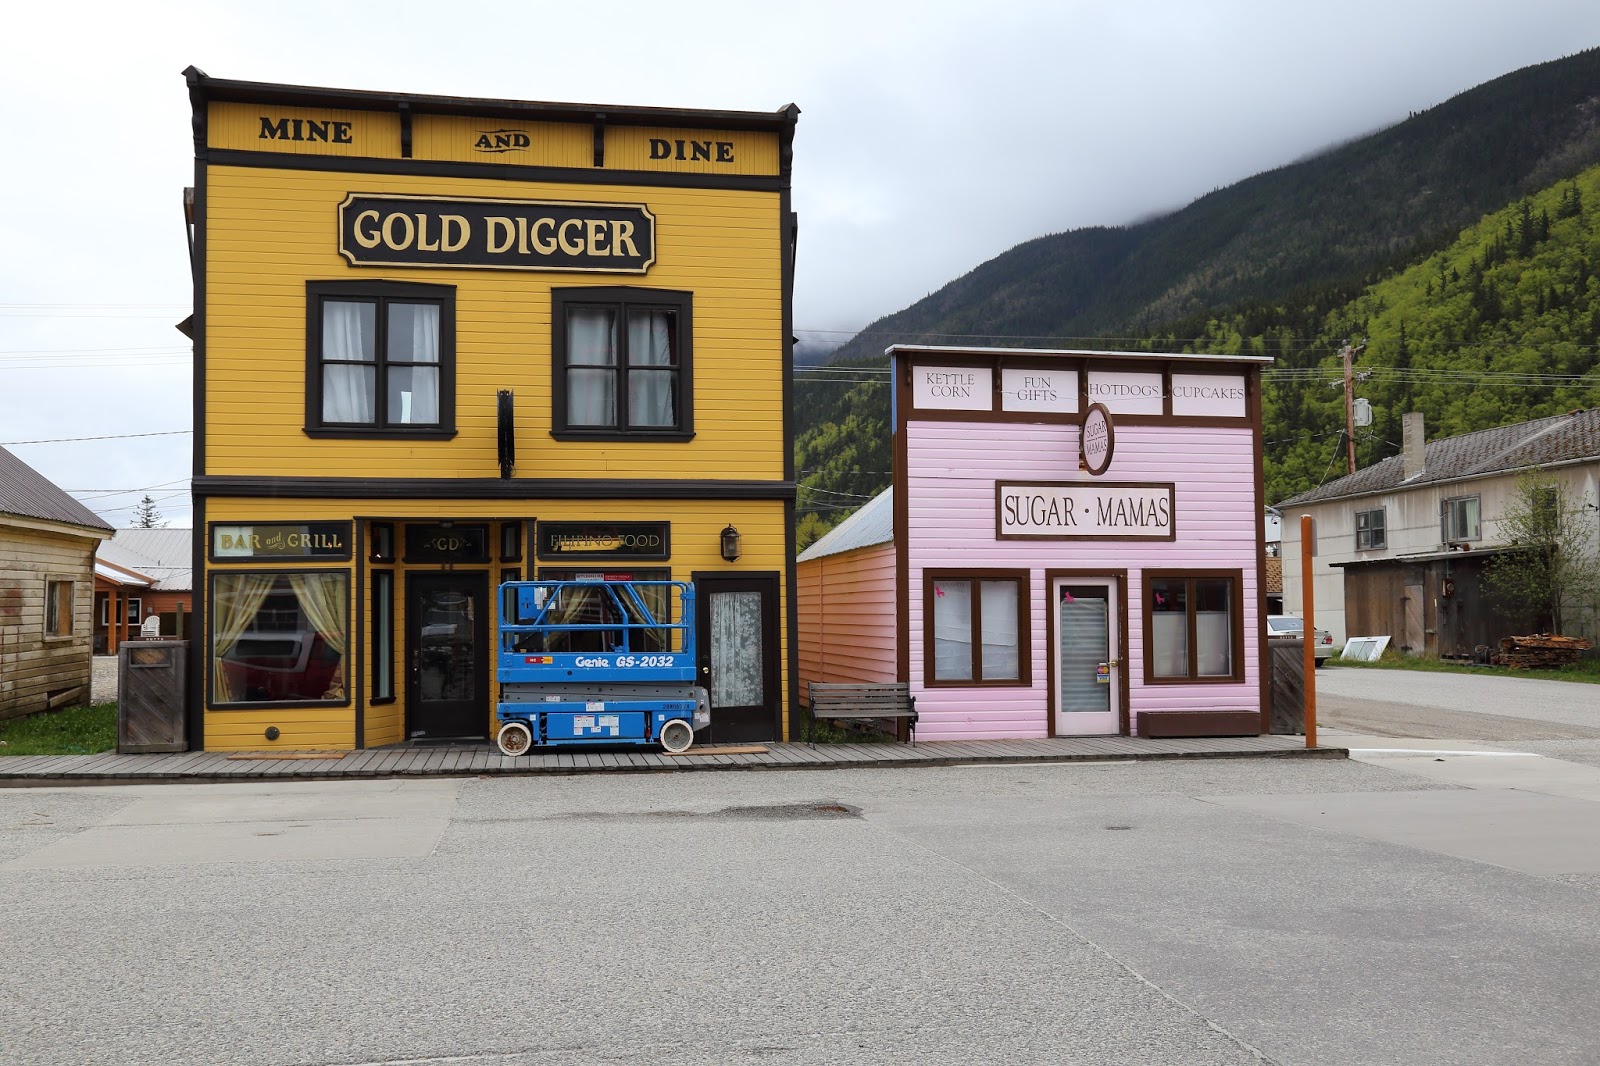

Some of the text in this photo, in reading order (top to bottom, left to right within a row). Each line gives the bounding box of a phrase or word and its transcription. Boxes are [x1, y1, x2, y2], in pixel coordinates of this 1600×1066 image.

[258, 116, 353, 143] MINE
[474, 133, 531, 151] AND
[649, 138, 735, 163] DINE
[353, 209, 640, 257] GOLD DIGGER
[926, 372, 975, 386] KETTLE
[1024, 377, 1051, 389] FUN
[931, 385, 971, 398] CORN
[1017, 389, 1057, 402] GIFTS
[1089, 383, 1159, 397] HOTDOGS
[1172, 386, 1244, 400] CUPCAKES
[1086, 420, 1107, 438] SUGAR
[1004, 495, 1169, 527] SUGAR MAMAS
[220, 531, 343, 550] BAR and GRILL
[436, 537, 459, 551] GD
[550, 534, 660, 547] FILIPINO FOOD
[575, 655, 674, 668] Genie GS-2032
